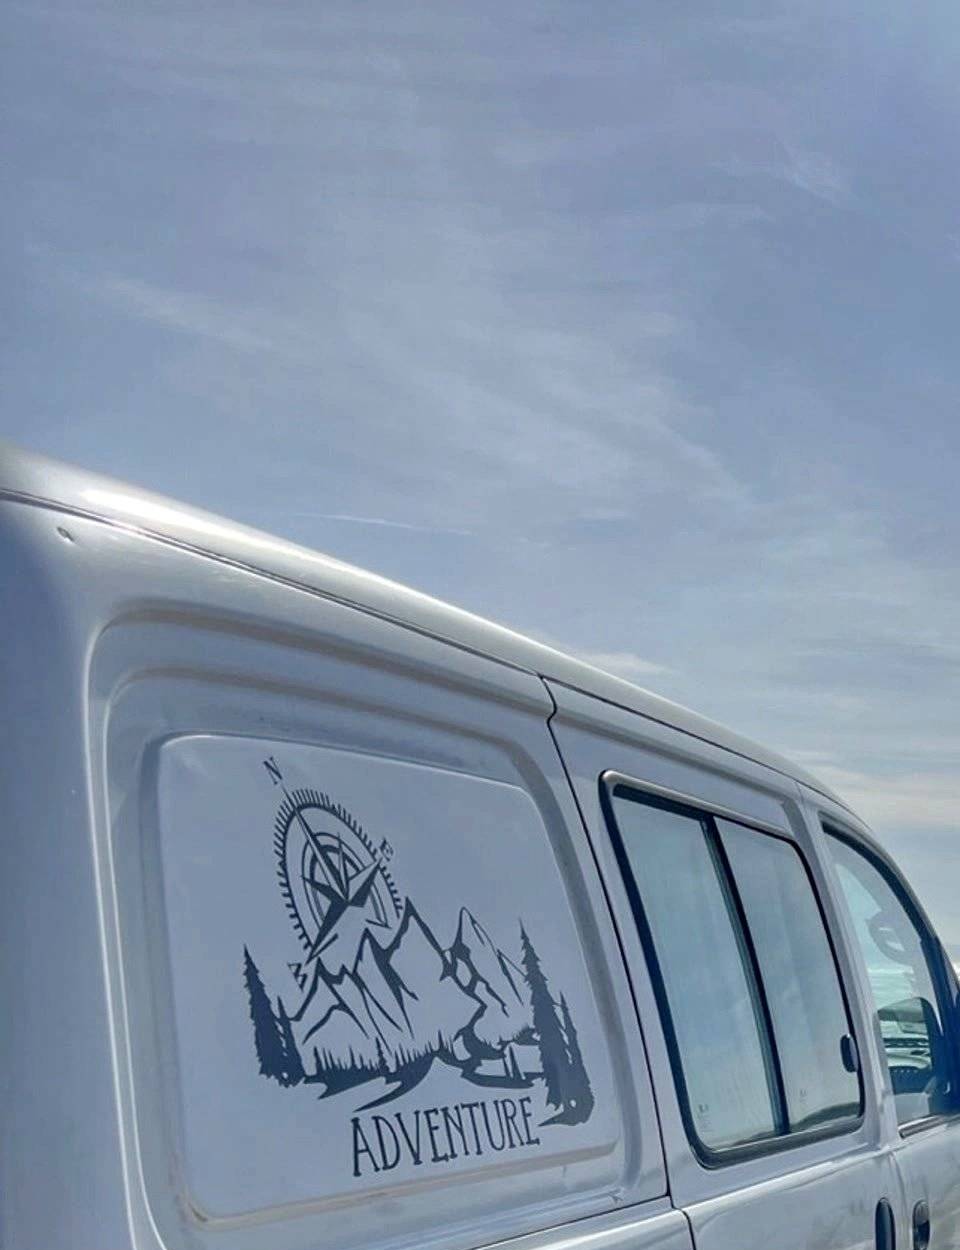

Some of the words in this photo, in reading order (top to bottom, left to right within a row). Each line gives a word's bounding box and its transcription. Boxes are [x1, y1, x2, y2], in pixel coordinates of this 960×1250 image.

[263, 756, 283, 785] N
[379, 837, 394, 862] E
[351, 1096, 540, 1177] ADVENTURE
